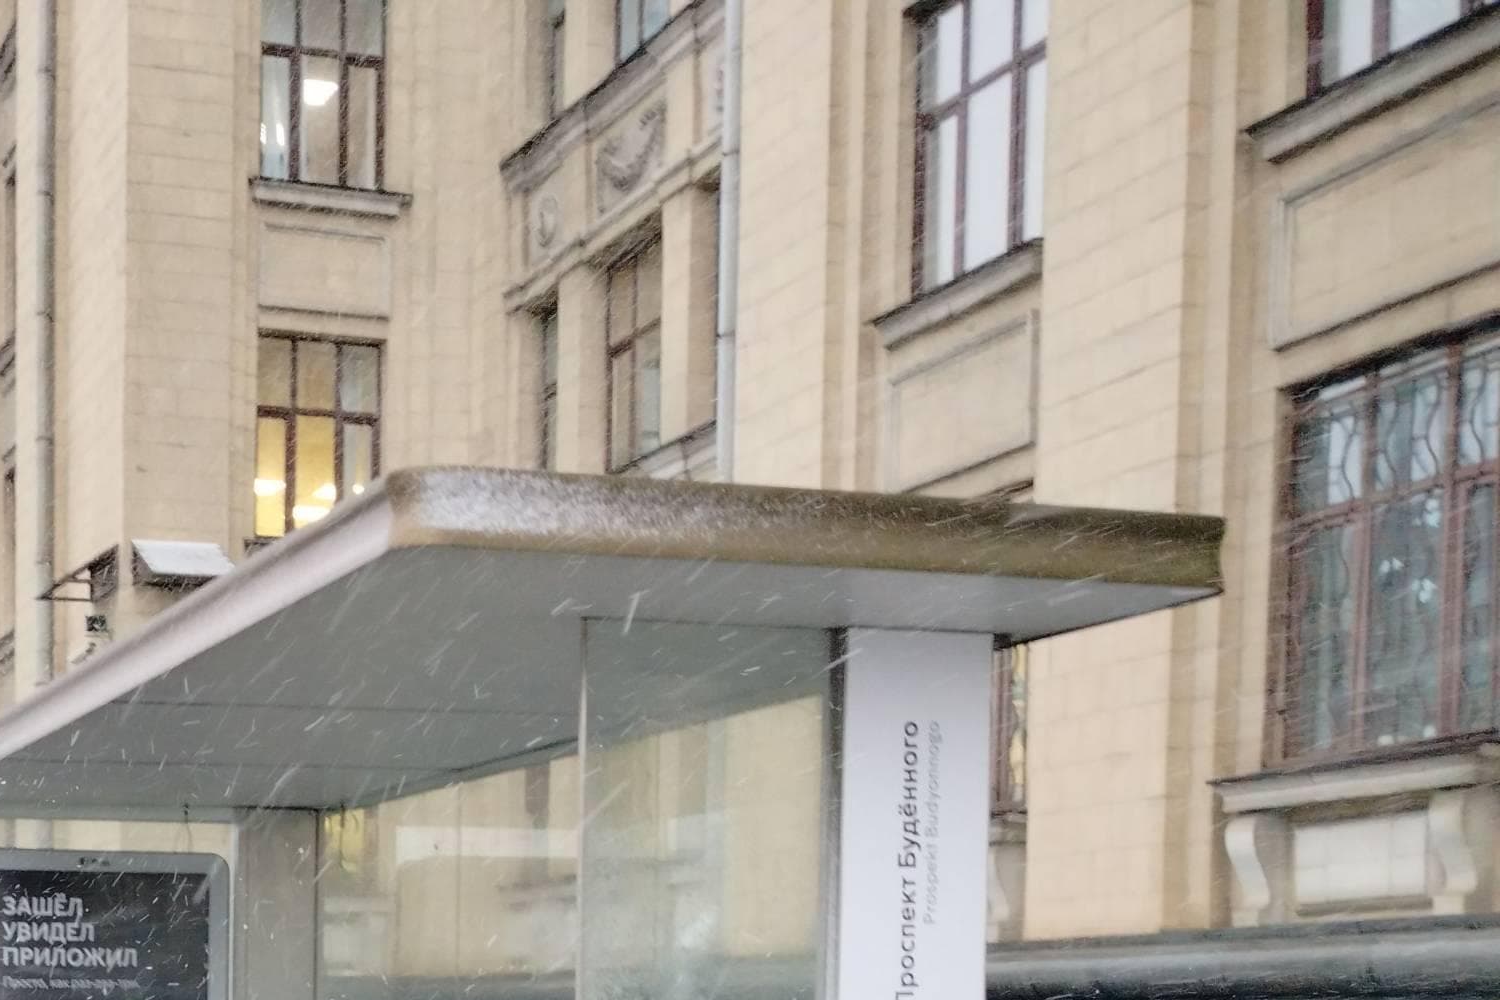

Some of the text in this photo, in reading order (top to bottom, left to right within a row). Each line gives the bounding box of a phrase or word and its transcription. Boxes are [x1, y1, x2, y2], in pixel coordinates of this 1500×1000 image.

[898, 720, 921, 868] Будённого
[922, 843, 939, 926] Prospekt
[2, 892, 84, 918] ЗАШЁЛ
[2, 921, 95, 944] УВИДЕЛ
[2, 947, 138, 968] ПРИЛОЖИЛ
